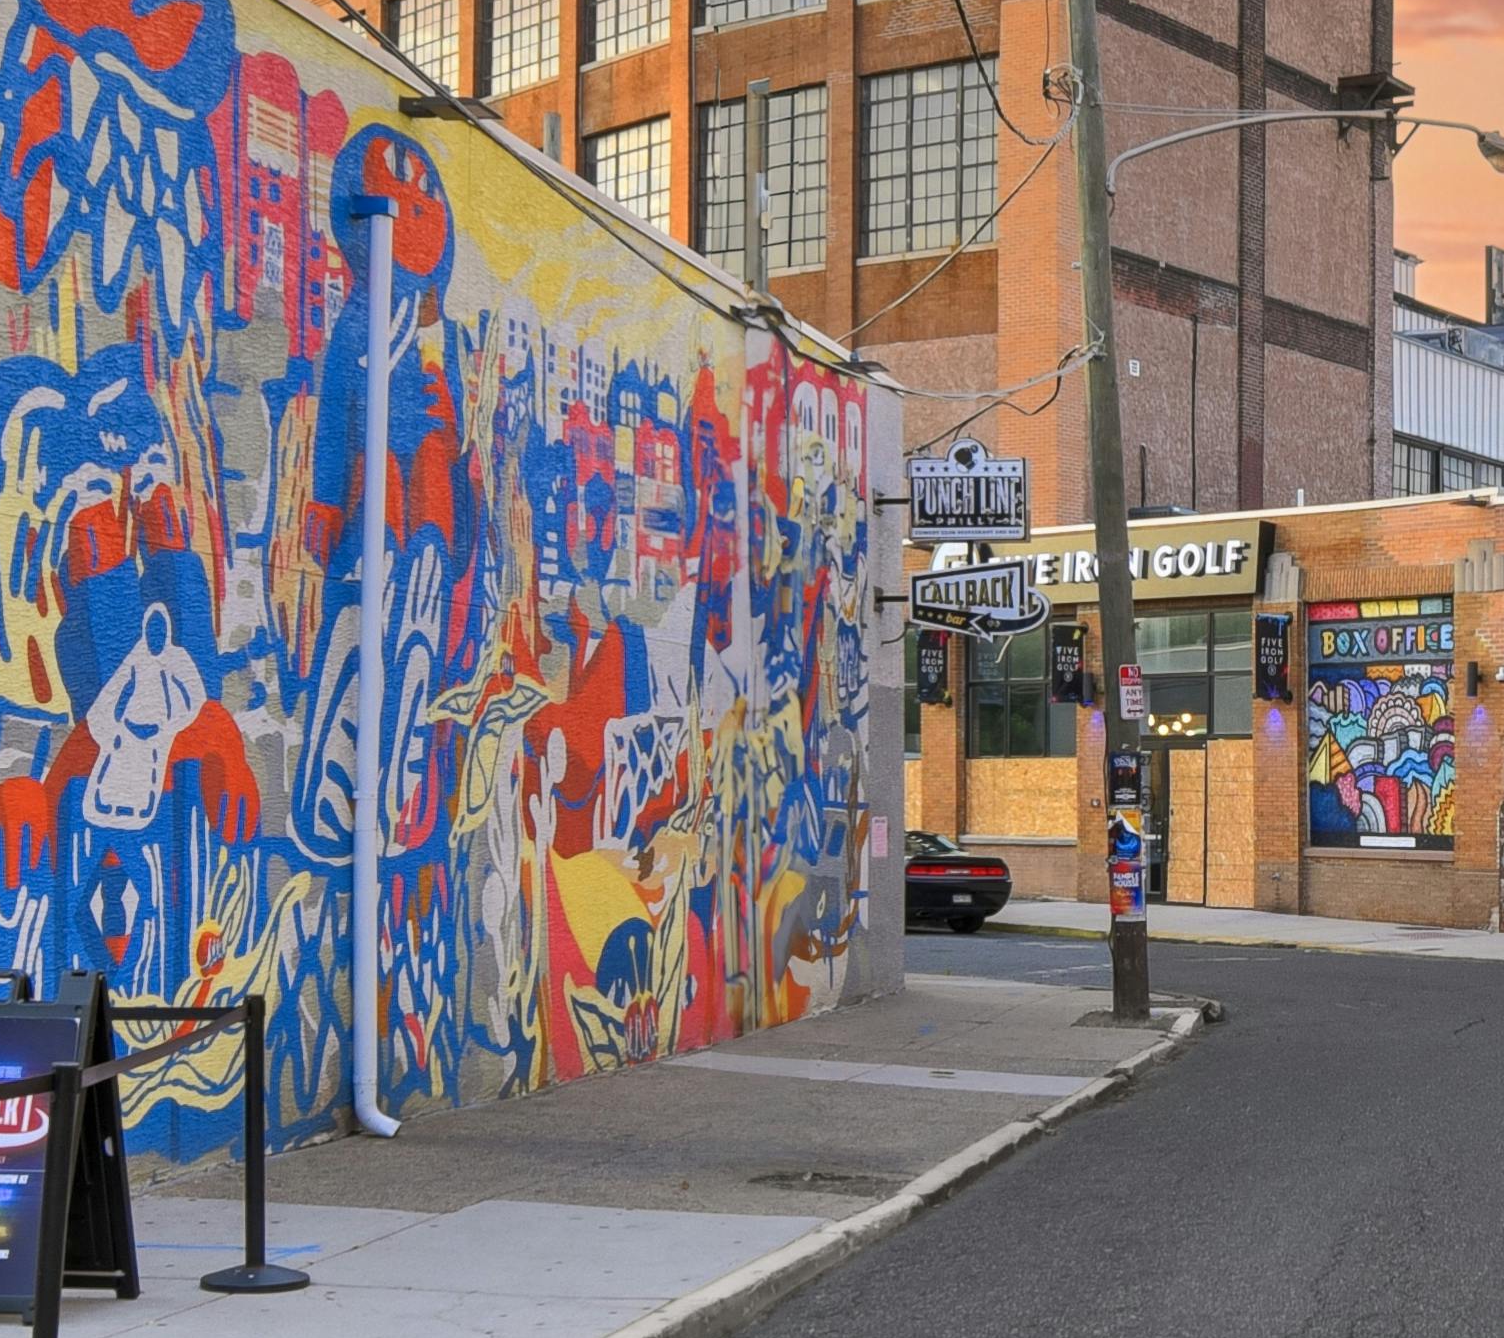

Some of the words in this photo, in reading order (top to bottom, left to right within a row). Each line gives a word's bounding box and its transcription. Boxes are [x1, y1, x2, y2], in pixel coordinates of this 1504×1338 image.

[913, 476, 975, 525] PUNCH
[979, 476, 1023, 525] LINE
[1153, 540, 1245, 579] GOLF
[921, 571, 1015, 609] CALLBACK
[946, 611, 965, 625] bar
[1261, 637, 1283, 647] FIVE
[1320, 628, 1369, 657] BOX
[1375, 623, 1454, 653] OFFICE
[921, 649, 944, 659] FIVE
[1056, 646, 1079, 656] FIVE
[1261, 648, 1284, 656] IRON
[1056, 655, 1079, 663] IRON
[1261, 657, 1284, 665] GOLF
[1056, 663, 1079, 672] GOLF
[1127, 667, 1139, 678] NO
[1125, 688, 1142, 697] ANY
[1126, 698, 1144, 706] TIME
